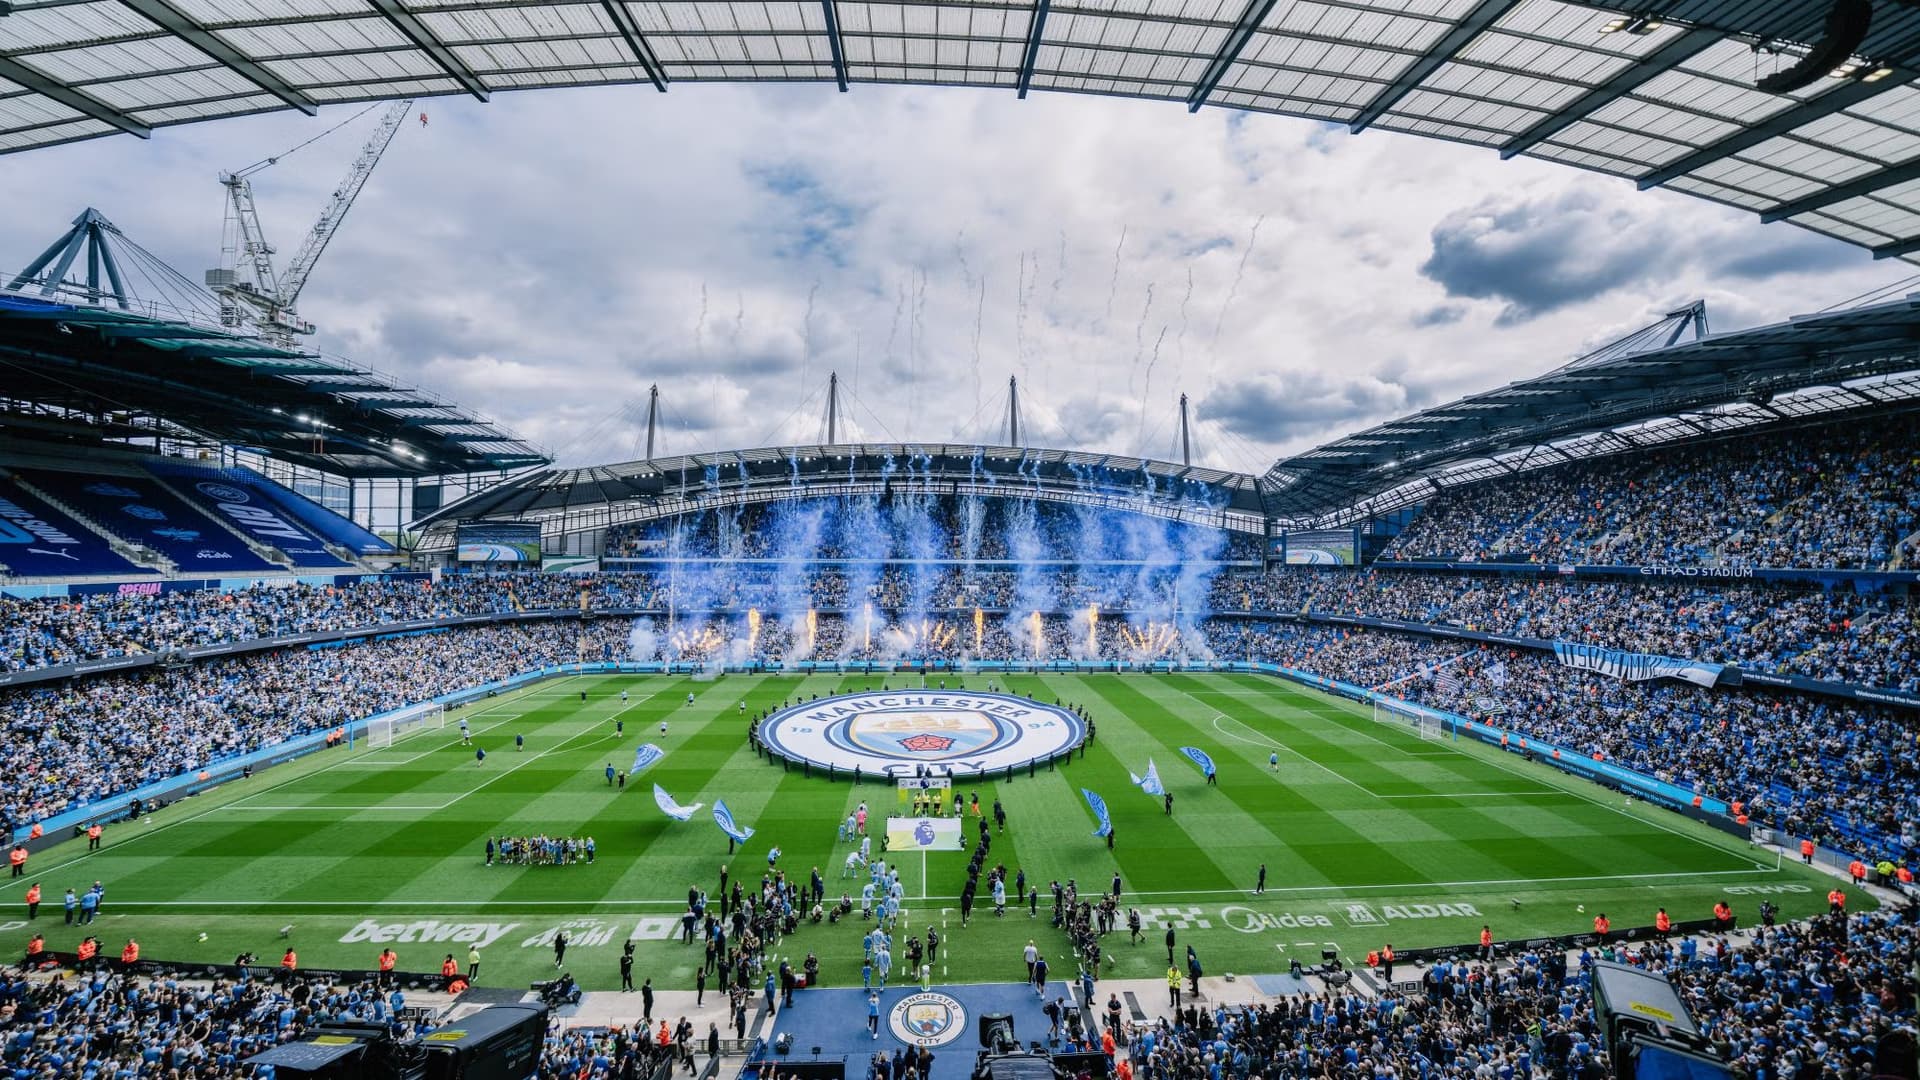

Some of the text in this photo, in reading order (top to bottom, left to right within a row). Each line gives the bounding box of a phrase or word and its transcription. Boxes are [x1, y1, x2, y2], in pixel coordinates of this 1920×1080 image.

[217, 503, 312, 541] CITY
[1640, 566, 1753, 578] ETIHAD STADIUM
[119, 583, 162, 594] SPECIAL
[1855, 689, 1885, 700] Welcome
[806, 697, 1031, 722] MANCHESTER
[881, 760, 986, 775] CITY
[1723, 884, 1812, 896] ETIHAD
[1383, 903, 1482, 919] ALDAR
[1244, 912, 1333, 929] Midea
[338, 919, 520, 949] betway
[895, 992, 960, 1012] MANCHESTER
